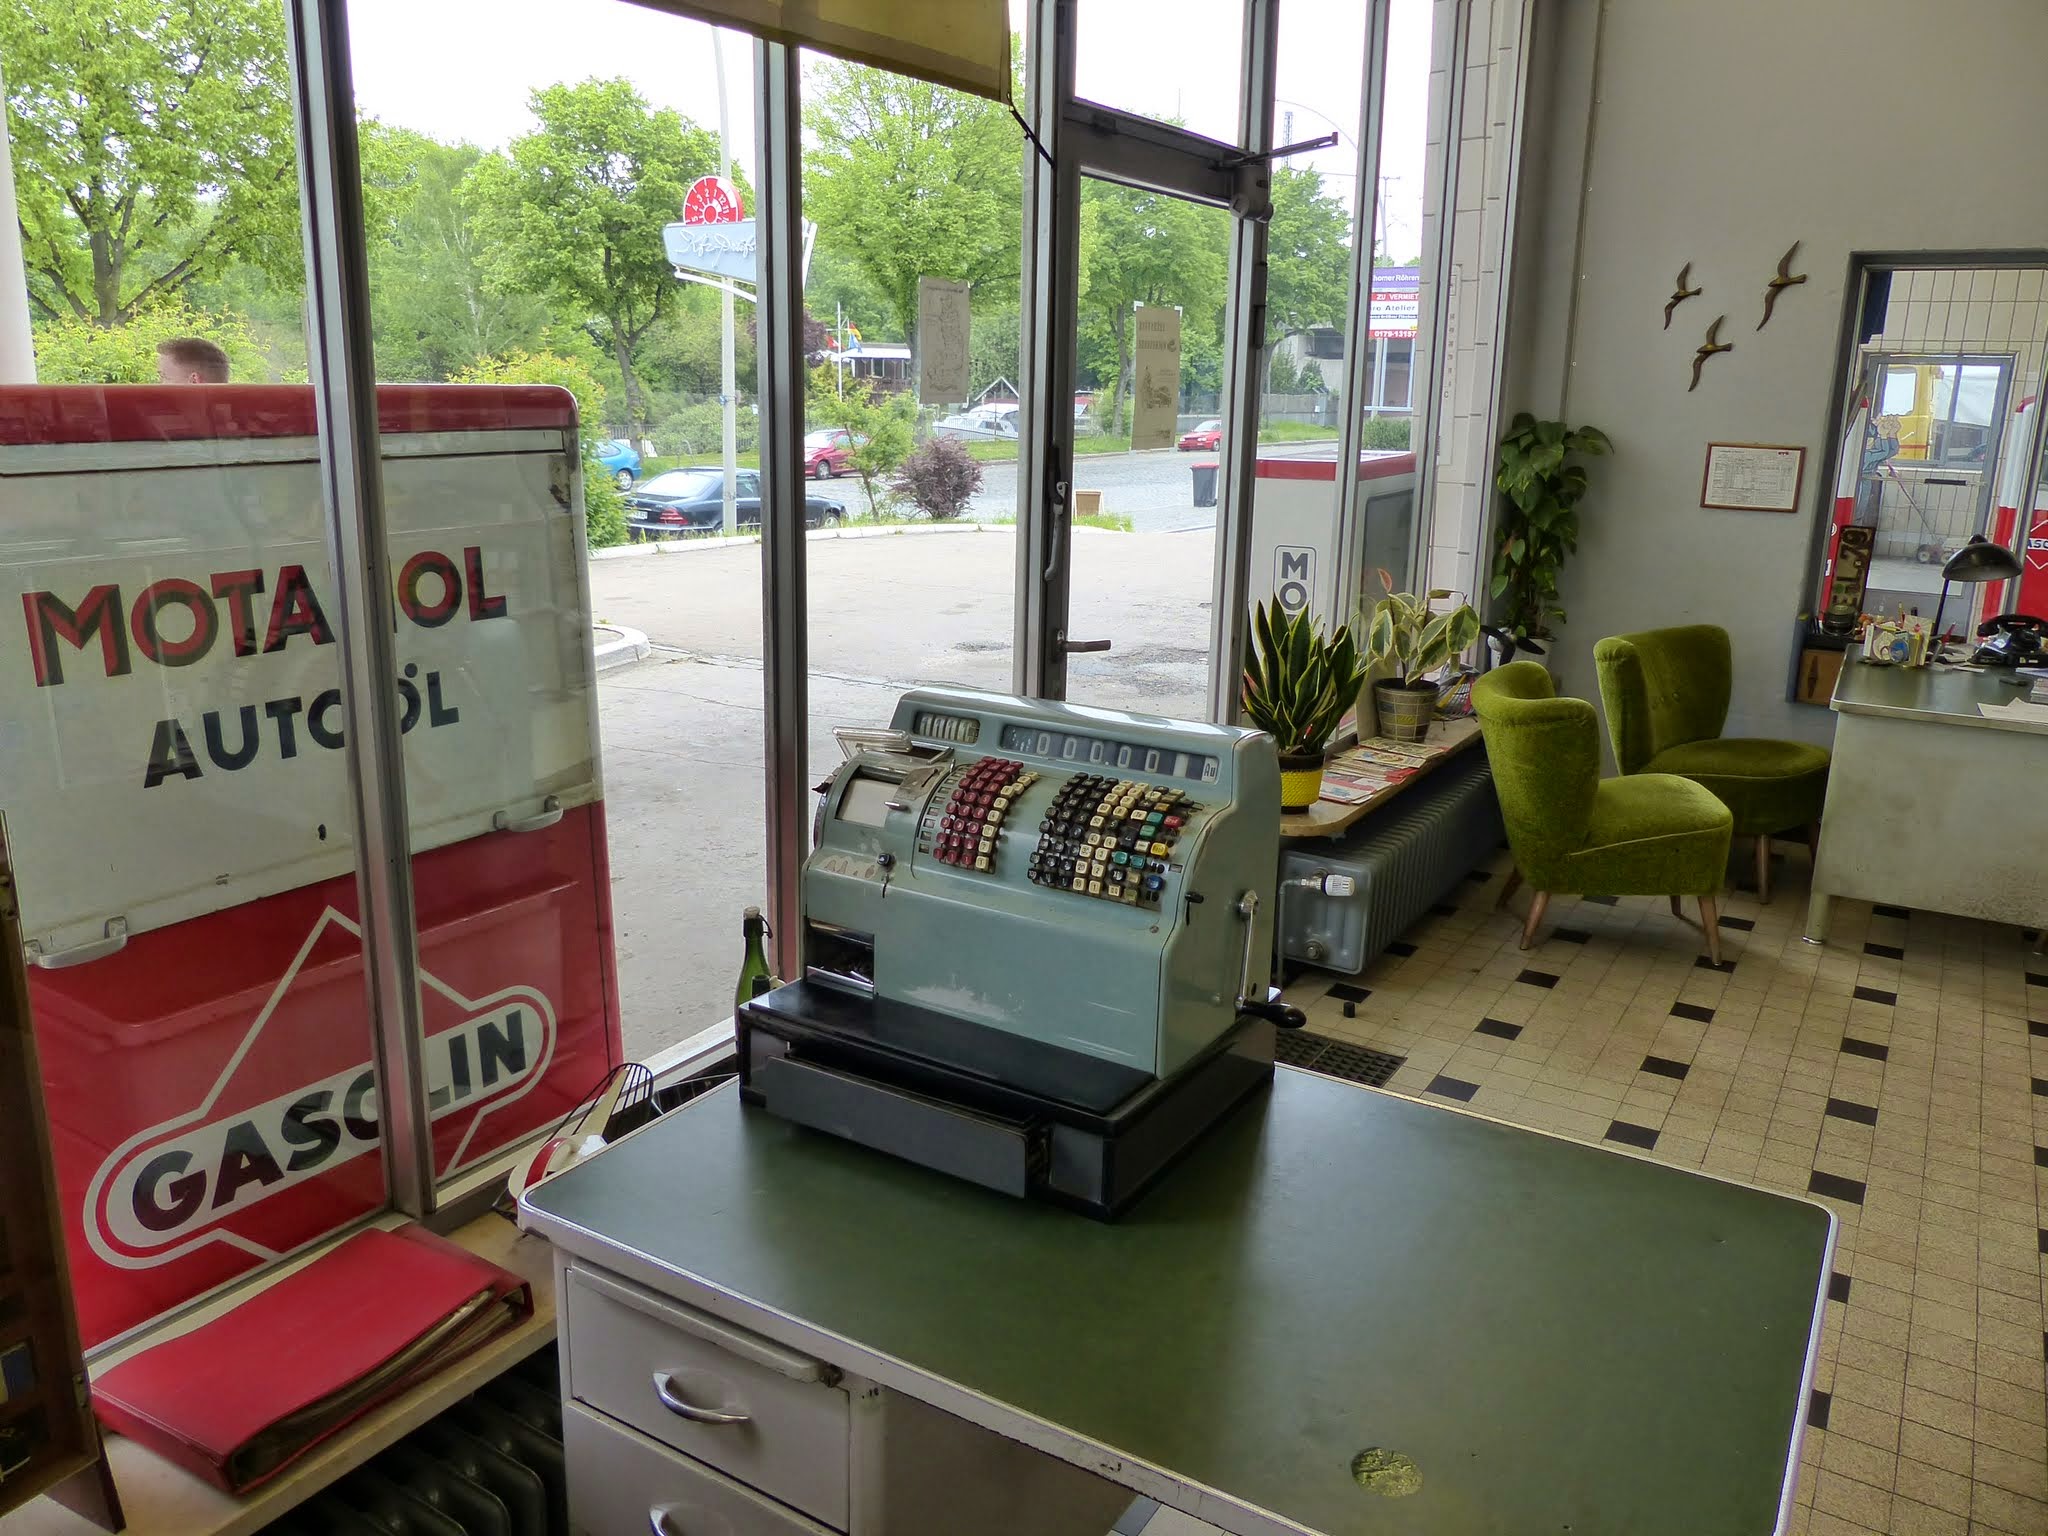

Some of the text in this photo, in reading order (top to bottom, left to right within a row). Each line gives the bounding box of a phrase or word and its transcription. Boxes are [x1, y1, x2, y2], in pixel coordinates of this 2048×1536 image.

[696, 194, 703, 202] 3
[704, 188, 710, 197] 2
[22, 546, 508, 688] MOTAOL
[132, 1010, 527, 1232] GASOIN
